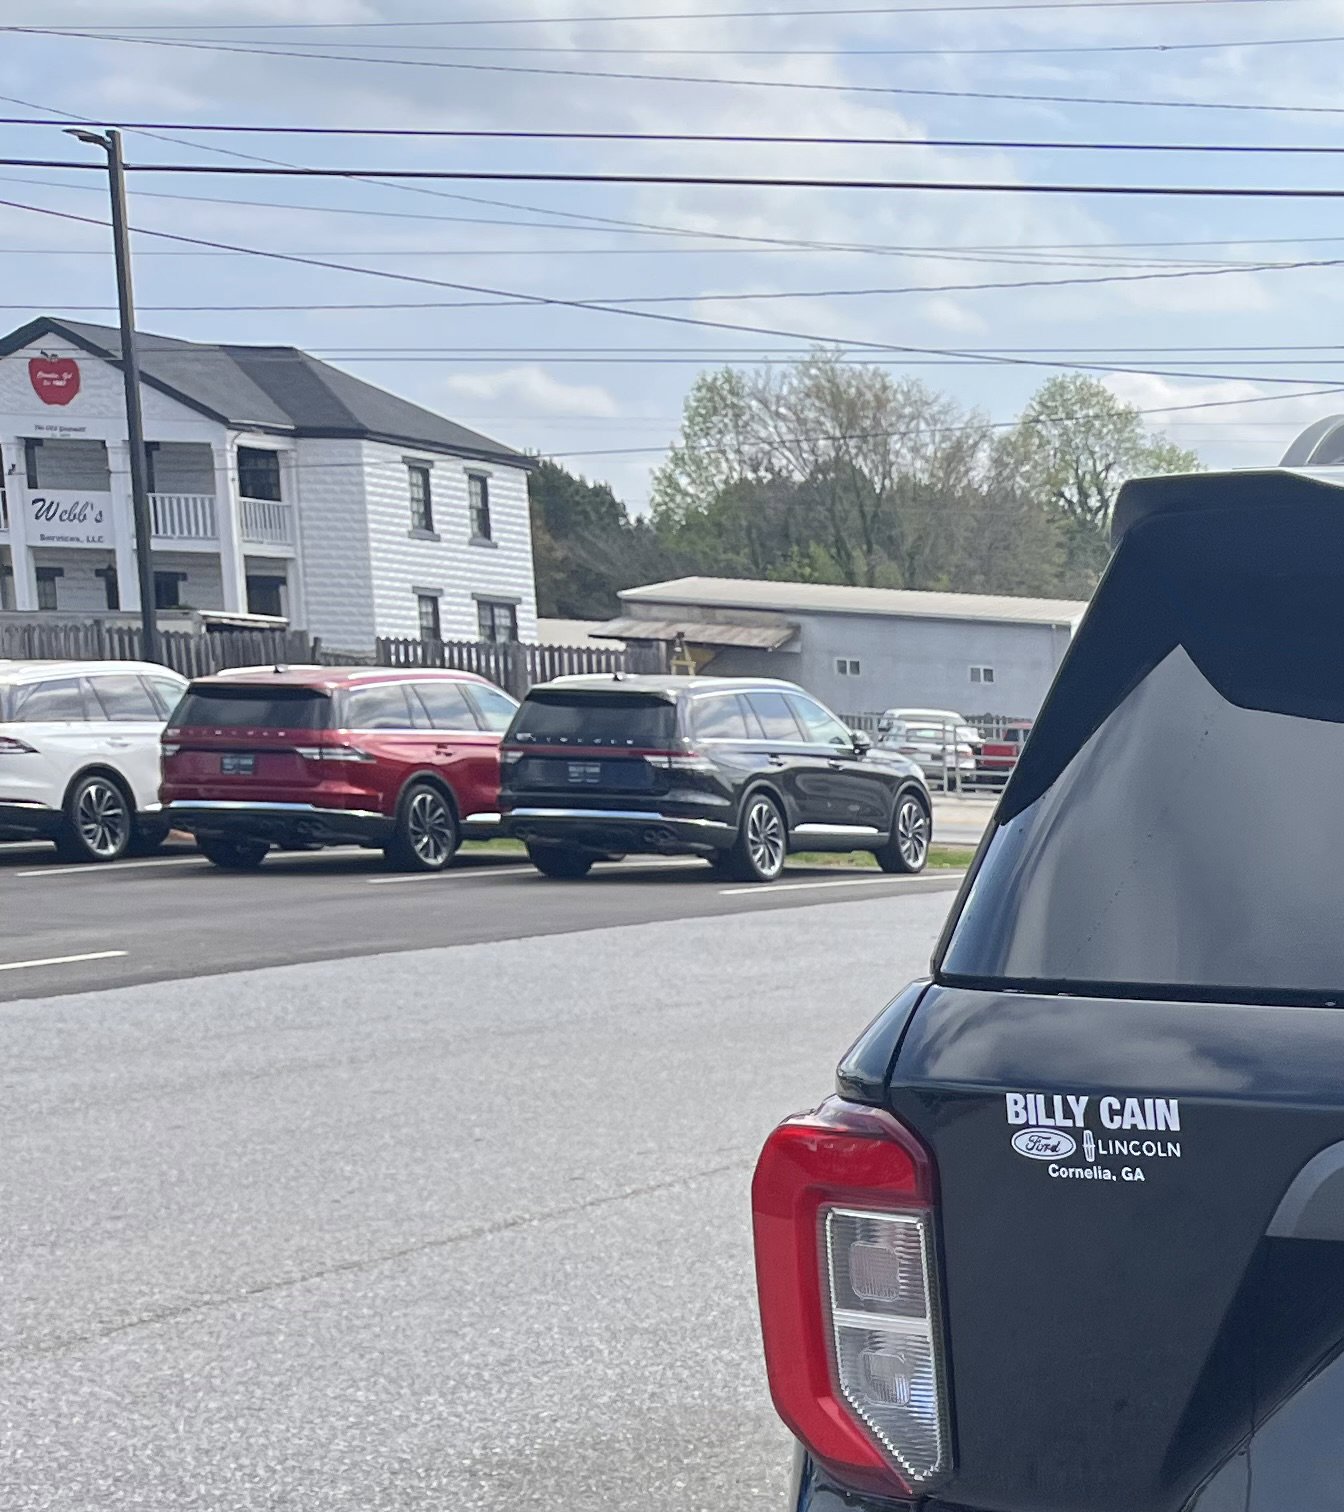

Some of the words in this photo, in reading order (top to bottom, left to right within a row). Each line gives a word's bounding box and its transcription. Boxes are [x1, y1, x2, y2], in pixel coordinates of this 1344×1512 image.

[31, 497, 103, 524] Webb's
[1005, 1092, 1089, 1128] BILLY
[1099, 1096, 1181, 1132] CAIN
[1024, 1134, 1061, 1153] Ford
[1098, 1139, 1181, 1158] LINCOLN
[1048, 1163, 1117, 1182] Cornelia,
[1121, 1167, 1146, 1182] GA
